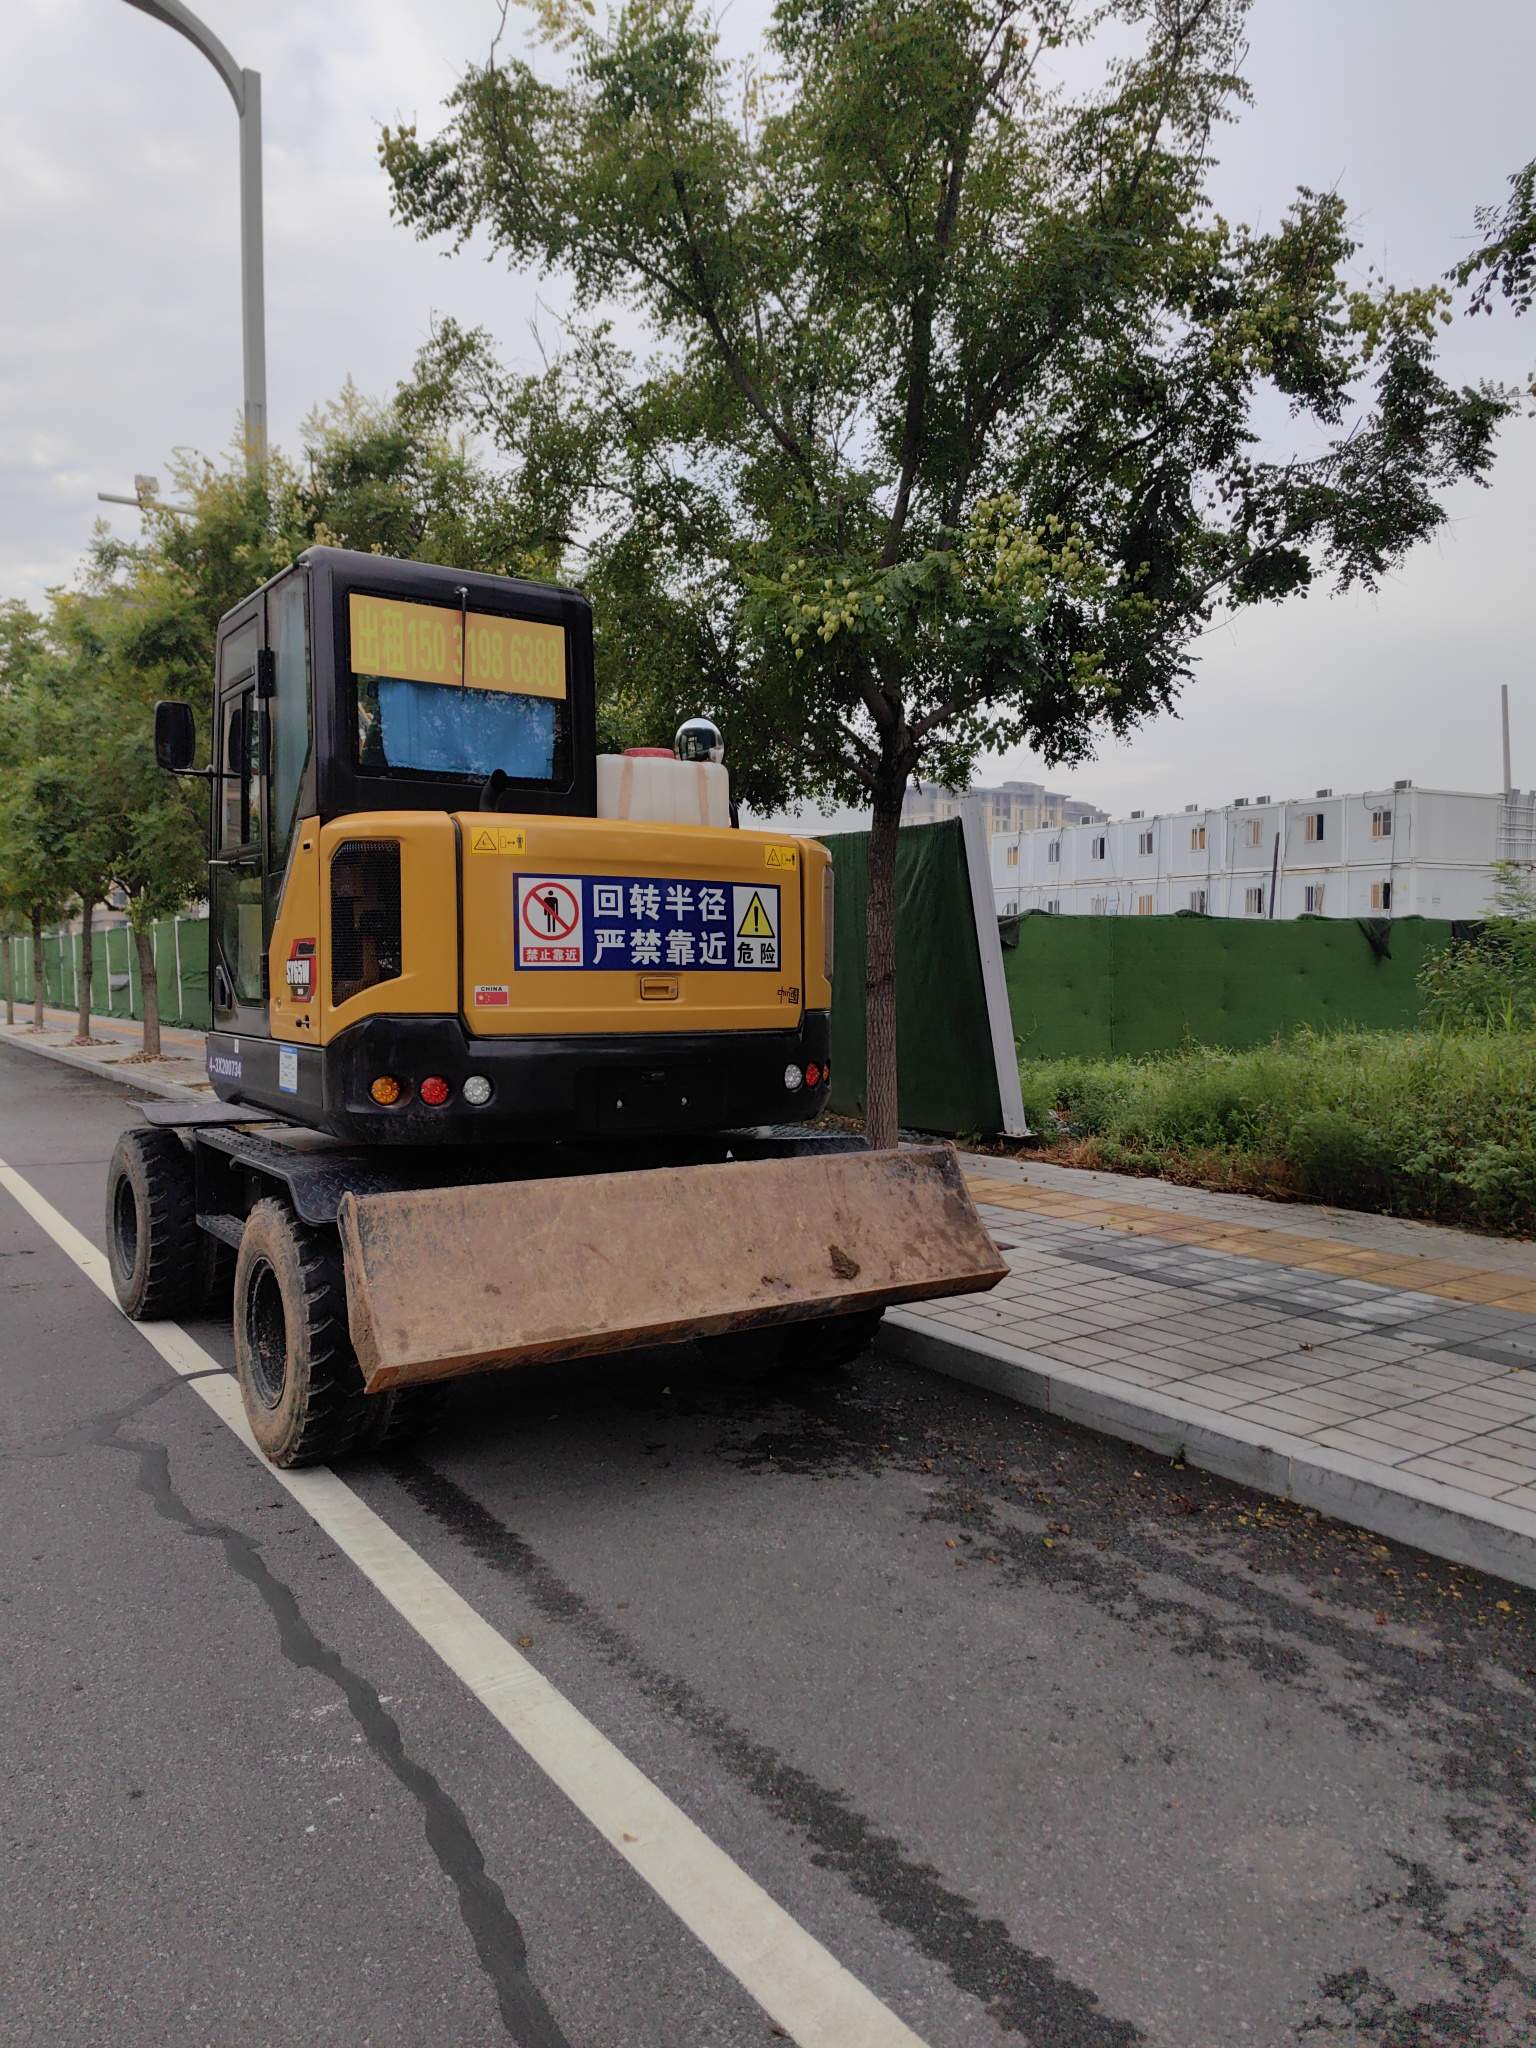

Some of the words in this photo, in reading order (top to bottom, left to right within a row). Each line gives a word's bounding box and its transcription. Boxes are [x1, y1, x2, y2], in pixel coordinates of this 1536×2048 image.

[593, 884, 727, 921] 回转半径
[526, 948, 577, 962] 禁止靠近
[593, 929, 727, 965] 严禁靠近
[737, 942, 775, 964] 危险
